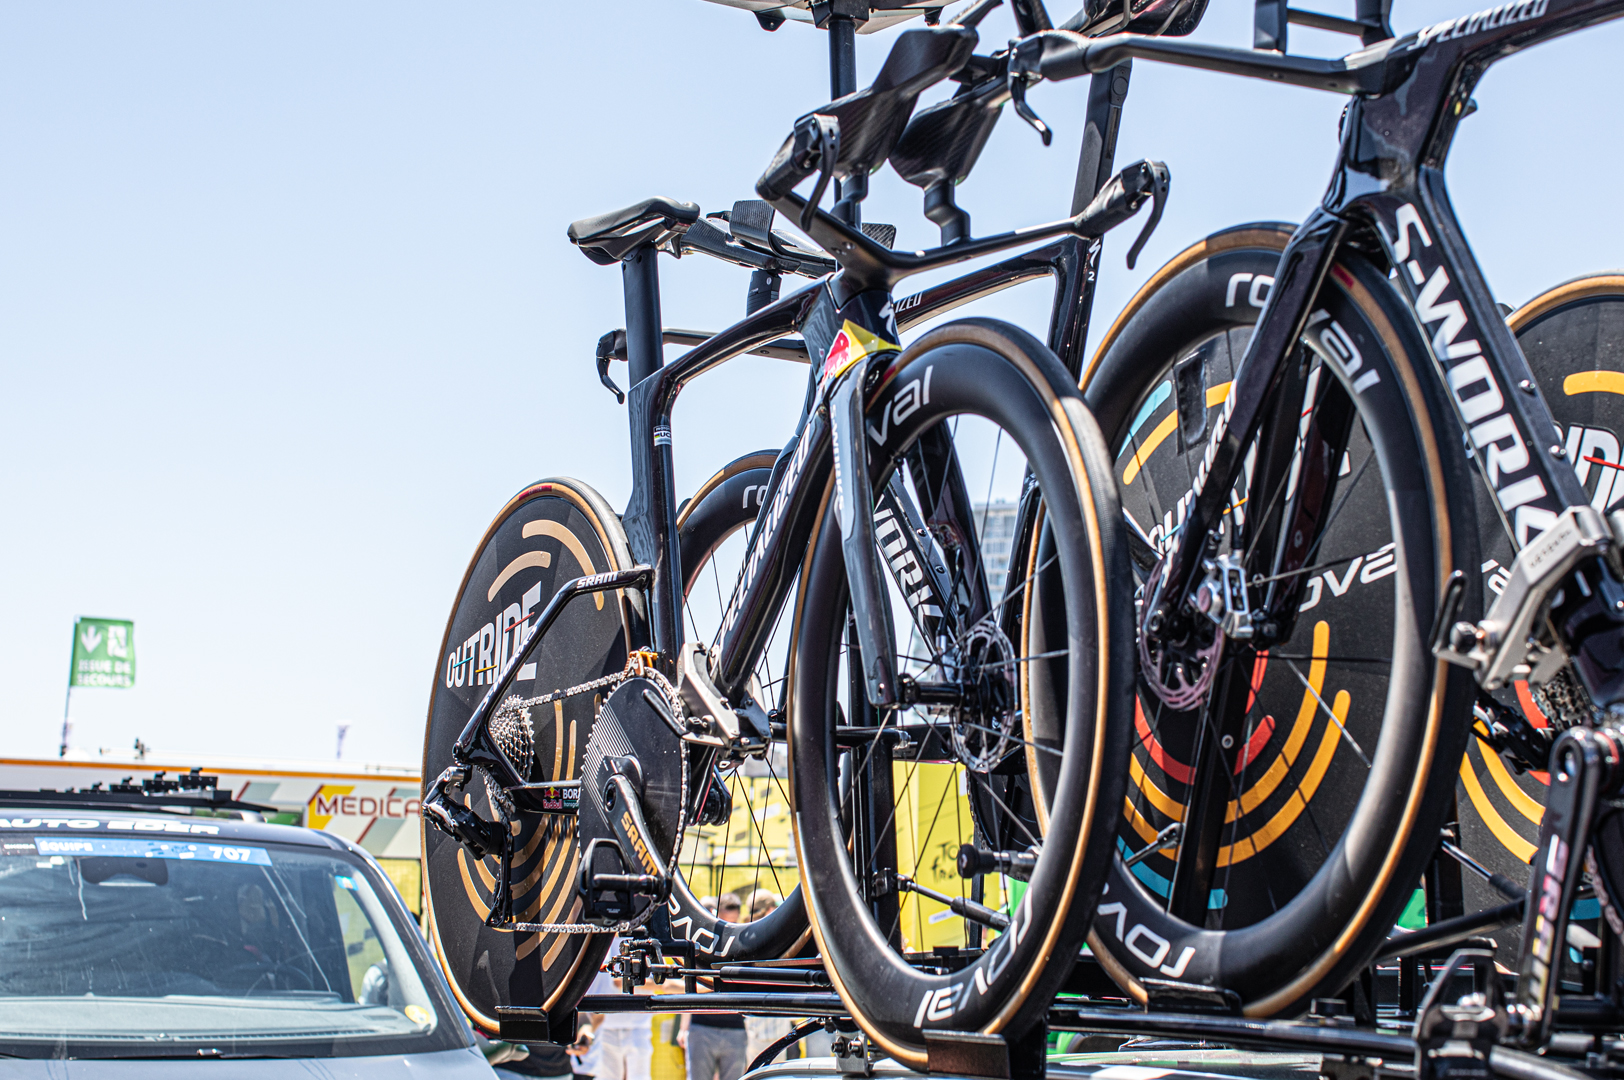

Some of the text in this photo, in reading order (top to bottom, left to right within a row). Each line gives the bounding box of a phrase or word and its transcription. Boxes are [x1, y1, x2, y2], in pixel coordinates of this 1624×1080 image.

[1087, 270, 1096, 282] 2
[1393, 205, 1561, 553] S-WORK
[576, 572, 618, 589] SRAM
[446, 580, 542, 689] OUTRIDE
[316, 795, 420, 819] MEDICA
[0, 818, 220, 835] AUTO EDER
[208, 846, 251, 861] 707
[620, 811, 658, 876] SRAM
